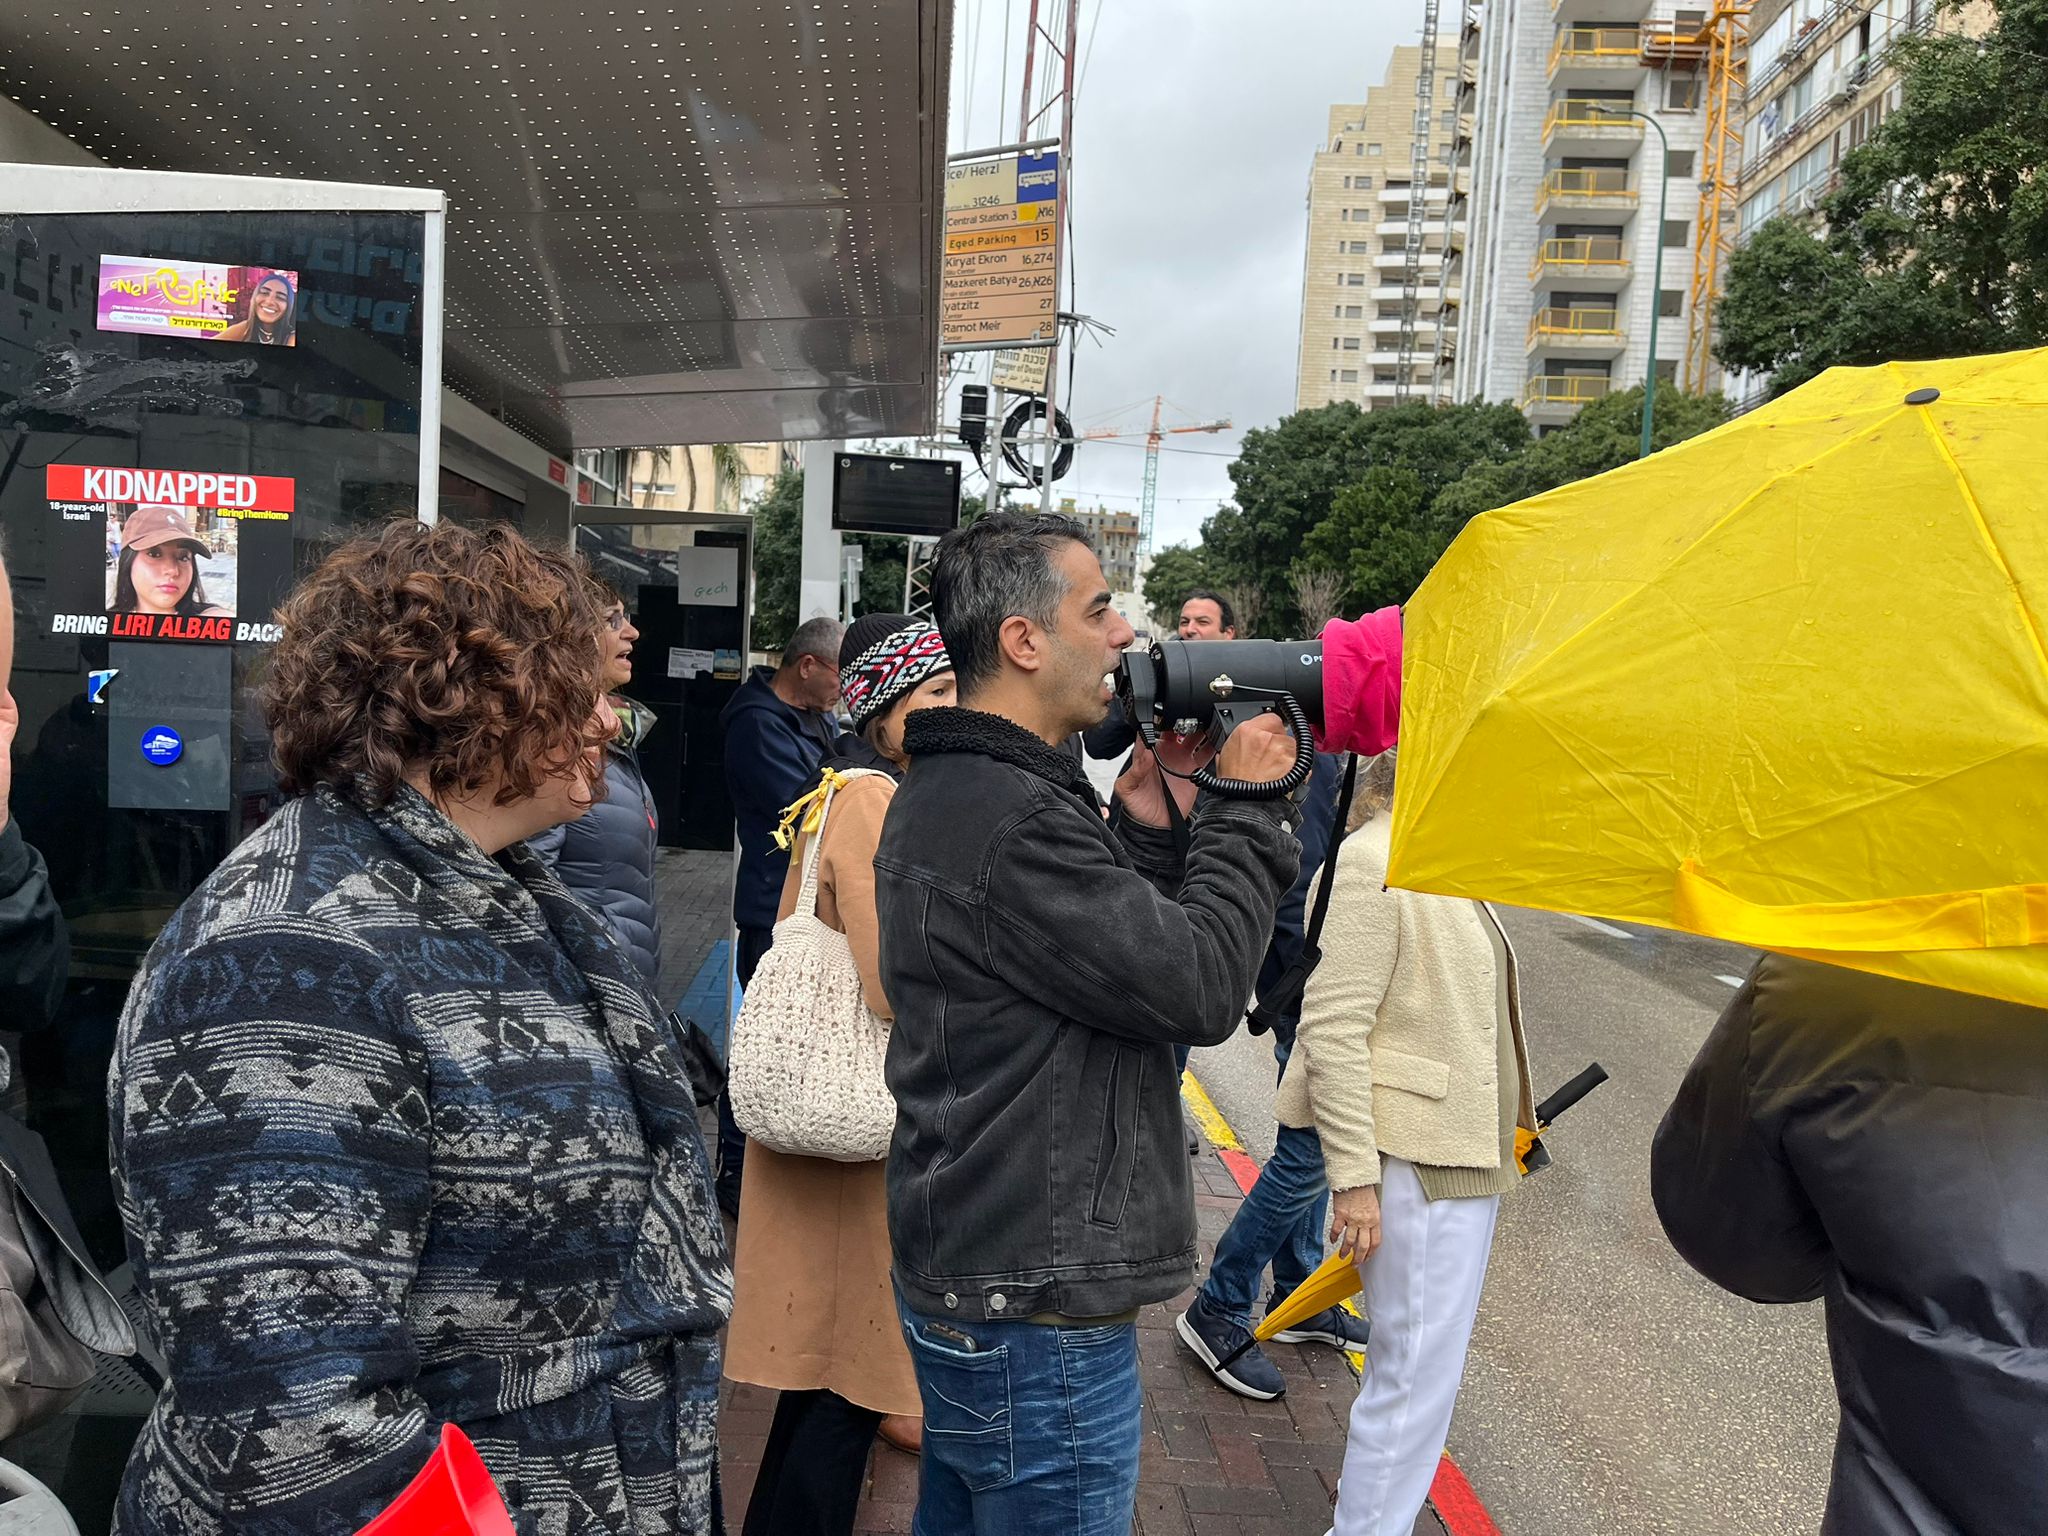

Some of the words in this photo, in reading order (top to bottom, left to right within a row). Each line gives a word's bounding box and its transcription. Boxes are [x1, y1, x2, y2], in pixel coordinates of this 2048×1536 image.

[970, 163, 1000, 177] Herzl
[972, 195, 1000, 208] 31246
[947, 213, 978, 227] Central
[979, 211, 1009, 224] Station
[1011, 210, 1017, 220] 3
[949, 237, 974, 249] Eged
[977, 234, 1017, 246] Parking
[1034, 228, 1049, 242] 15
[945, 256, 976, 269] Kiryat
[978, 254, 1007, 265] Ekron
[945, 277, 988, 289] Mazkeret
[989, 275, 1018, 287] Batya
[944, 299, 980, 313] yatzitz
[1039, 298, 1053, 310] 27
[943, 321, 976, 333] Ramot
[980, 320, 1001, 332] Meir
[1039, 321, 1053, 332] 28
[83, 468, 257, 507] KIDNAPPED
[49, 501, 105, 513] 18-years-old
[62, 512, 90, 521] Israeli
[216, 509, 290, 521] #BringThemHome
[52, 614, 108, 635] BRING
[112, 616, 152, 637] LIRI
[158, 617, 231, 640] ALBAG
